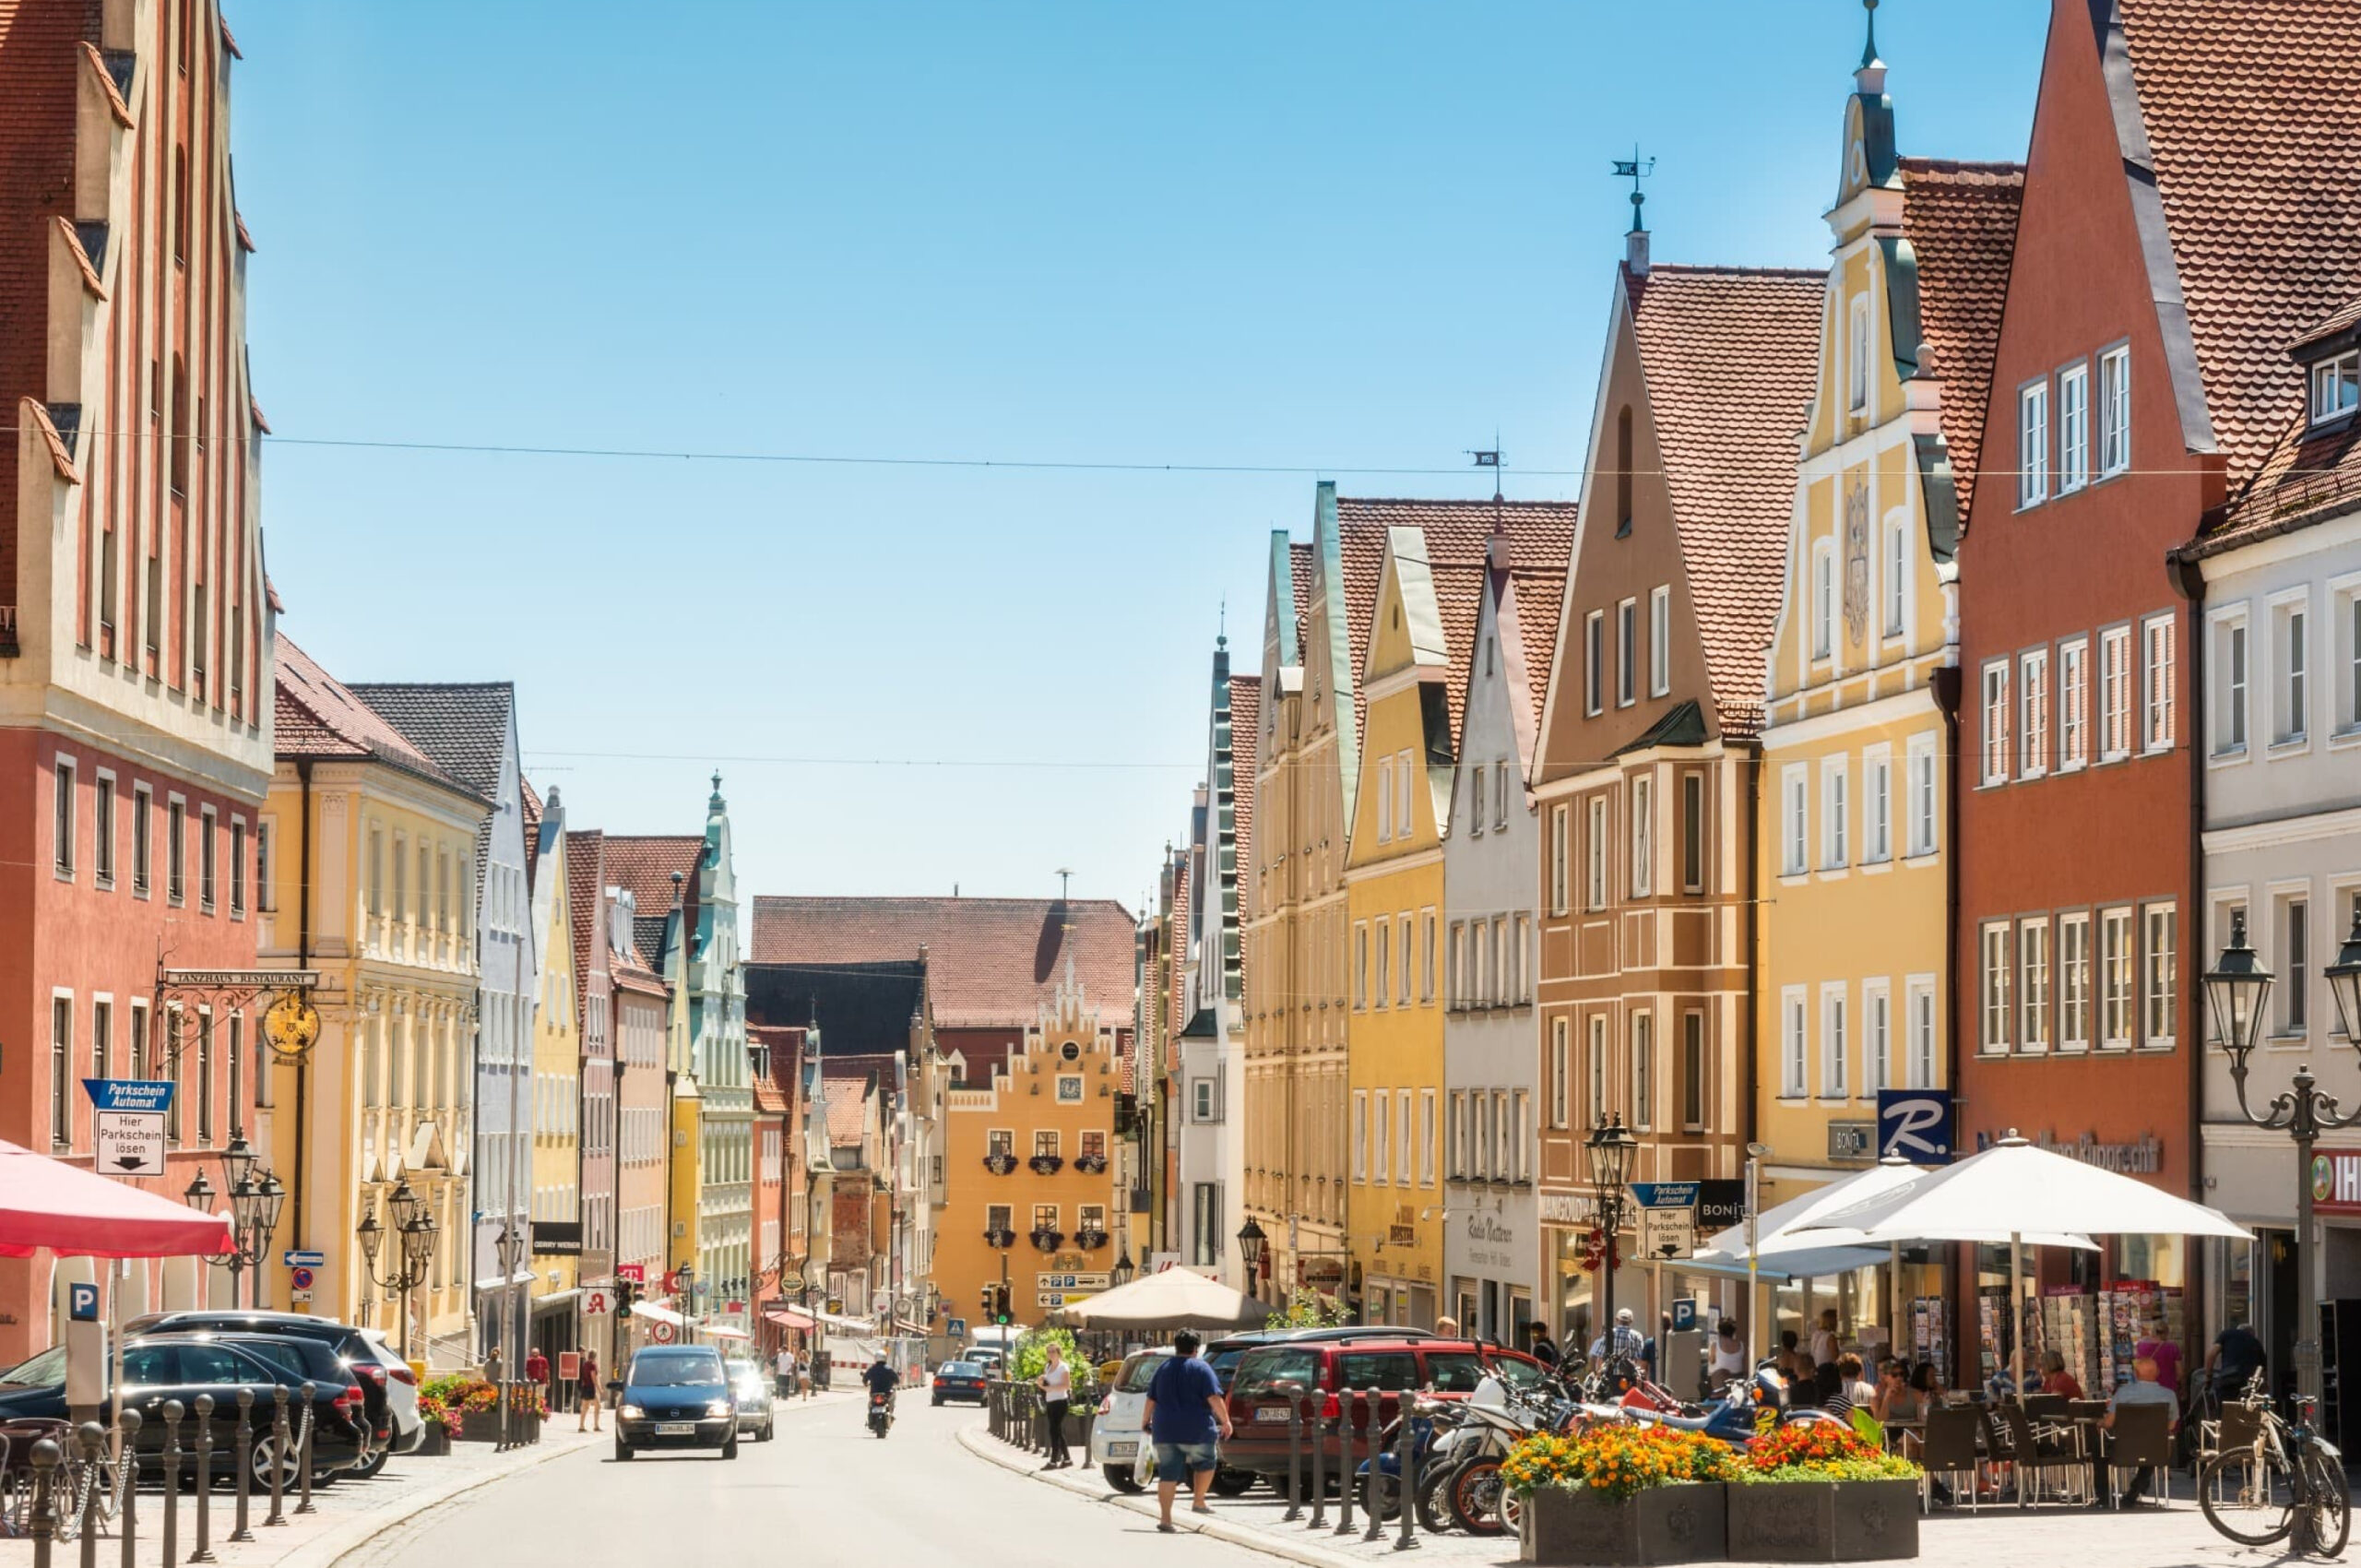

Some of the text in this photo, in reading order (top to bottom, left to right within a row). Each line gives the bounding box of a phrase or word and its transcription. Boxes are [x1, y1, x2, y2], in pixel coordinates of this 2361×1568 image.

[177, 974, 306, 983] TANZHAUS RESTAURANT
[108, 1084, 166, 1097] Parkschein
[112, 1097, 157, 1108] Automat
[119, 1116, 143, 1127] Hier
[101, 1129, 161, 1140] Parkschein
[115, 1142, 146, 1154] lösen
[1654, 1185, 1693, 1195] Parkschein
[1655, 1194, 1687, 1205] Automat
[1660, 1211, 1676, 1220] Hier
[1648, 1221, 1690, 1232] Parkschein
[1658, 1232, 1679, 1241] lösen
[76, 1289, 94, 1313] P
[1677, 1304, 1691, 1323] P
